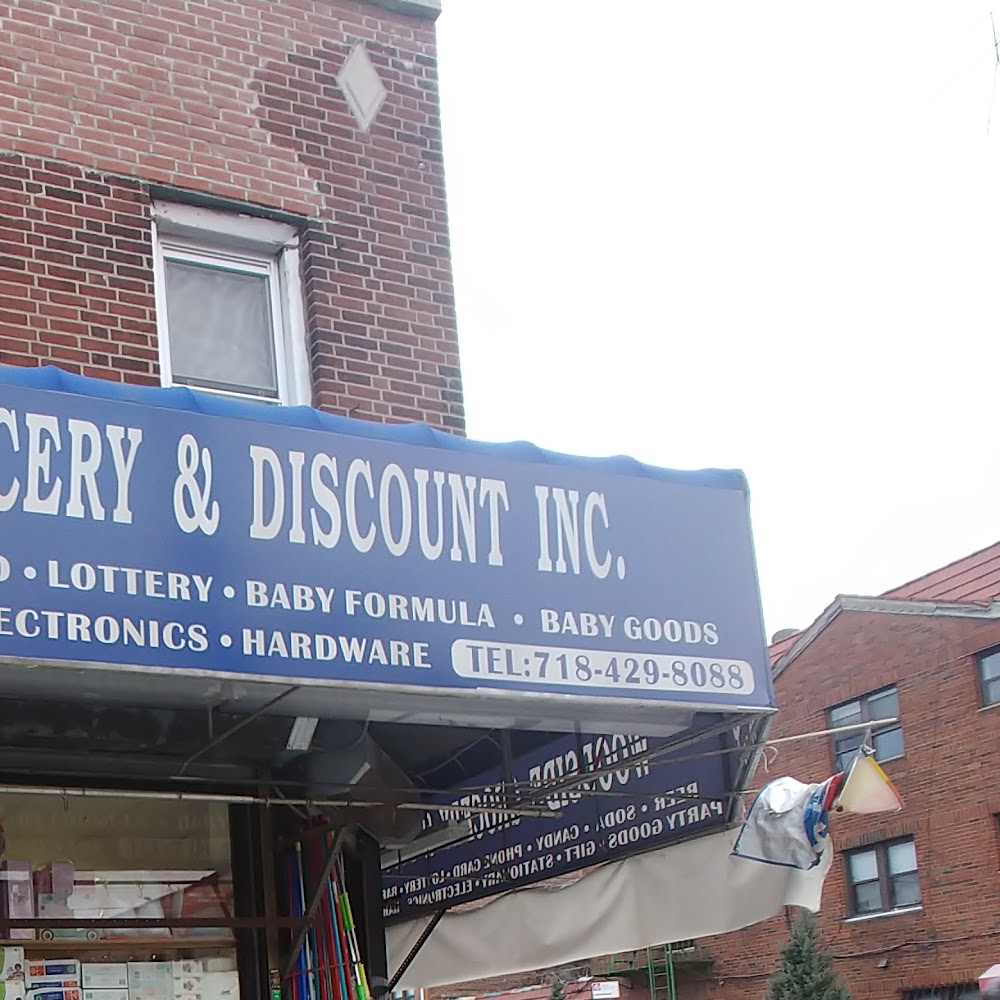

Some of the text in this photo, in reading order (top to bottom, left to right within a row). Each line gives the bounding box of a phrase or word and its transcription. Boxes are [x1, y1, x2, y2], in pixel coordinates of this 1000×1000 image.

[173, 433, 220, 536] &
[249, 444, 510, 567] DISCOUNT
[535, 484, 626, 580] INC.
[48, 559, 213, 602] LOTTERY
[246, 579, 335, 614] BABY
[345, 589, 496, 628] FORMULA
[540, 608, 615, 639] BABY
[623, 616, 719, 646] GOODS
[242, 628, 432, 669] HARDWARE
[466, 646, 745, 691] TEL:718-429-8088
